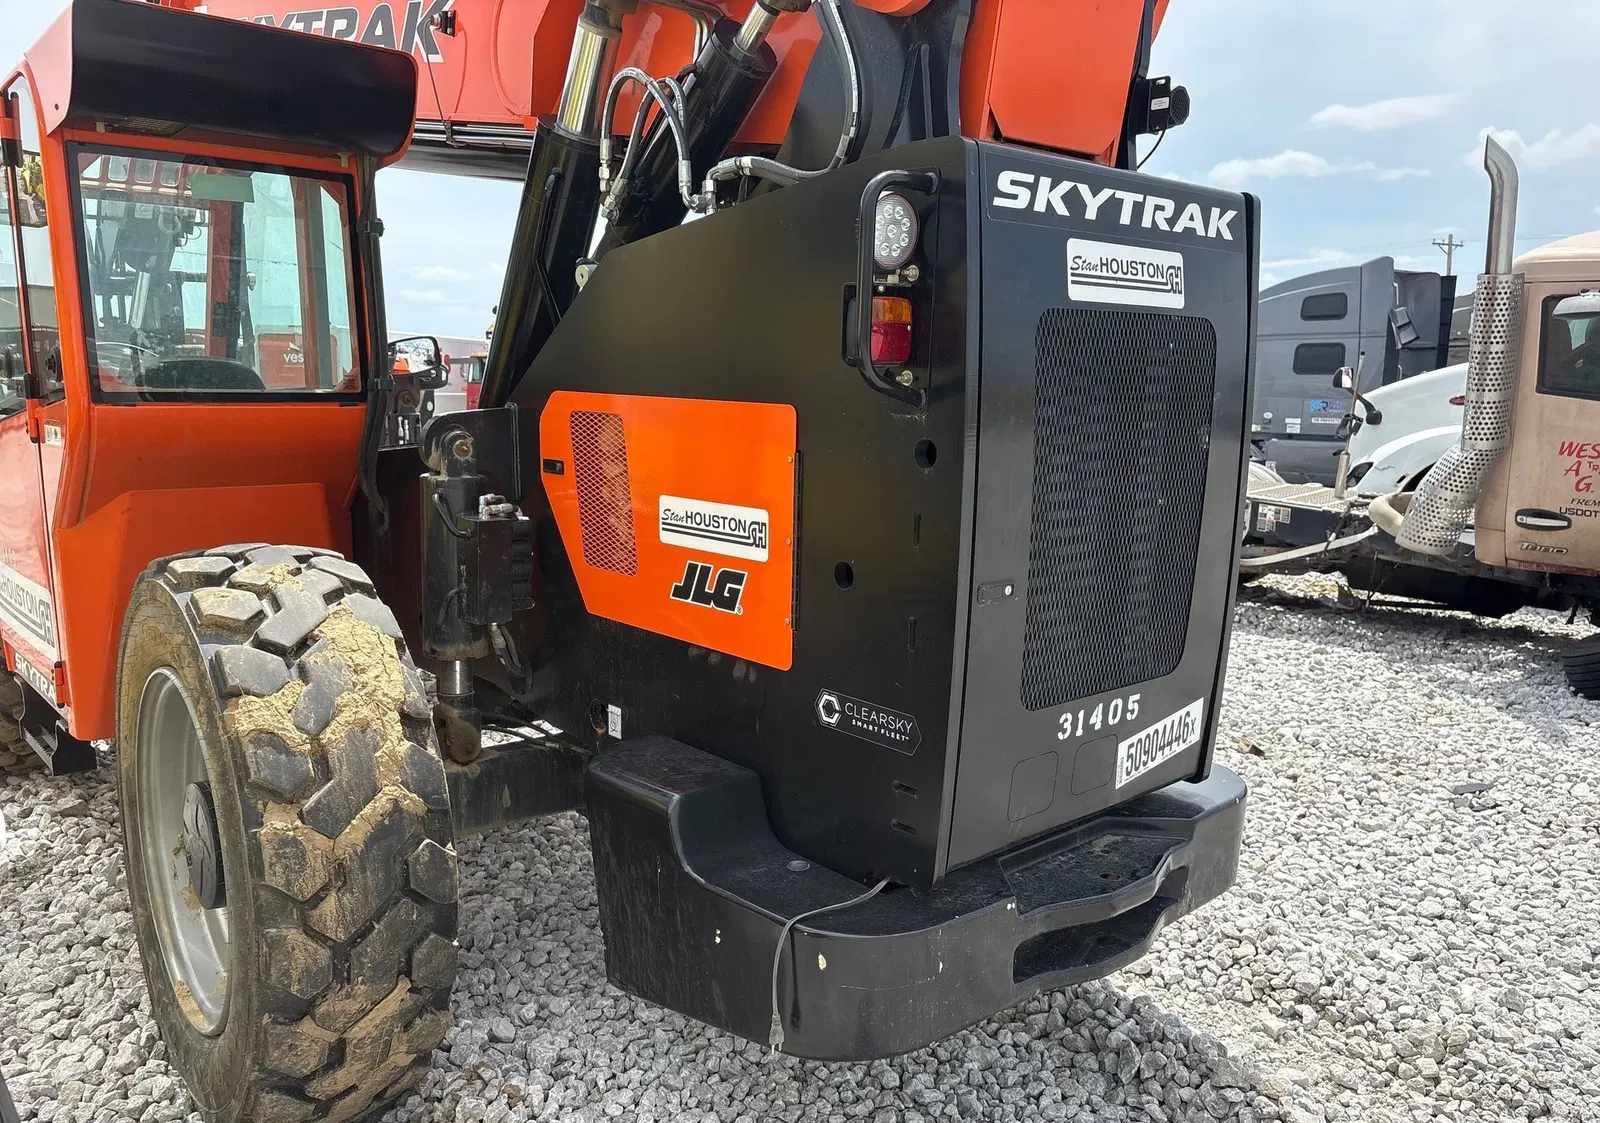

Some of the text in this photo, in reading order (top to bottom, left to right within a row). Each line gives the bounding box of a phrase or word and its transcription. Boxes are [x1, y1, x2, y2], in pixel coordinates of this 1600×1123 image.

[992, 170, 1239, 241] SKYTRAK
[1070, 255, 1099, 273] Stan
[1099, 257, 1165, 280] HOUSTON
[1563, 460, 1582, 477] A
[662, 507, 685, 523] Stan
[685, 510, 747, 534] HOUSTON
[1559, 507, 1600, 518] USDOT
[1, 571, 38, 618] HOUSTON
[845, 702, 913, 734] CLEARSKY
[852, 719, 878, 733] SMART
[1057, 693, 1141, 741] 31405
